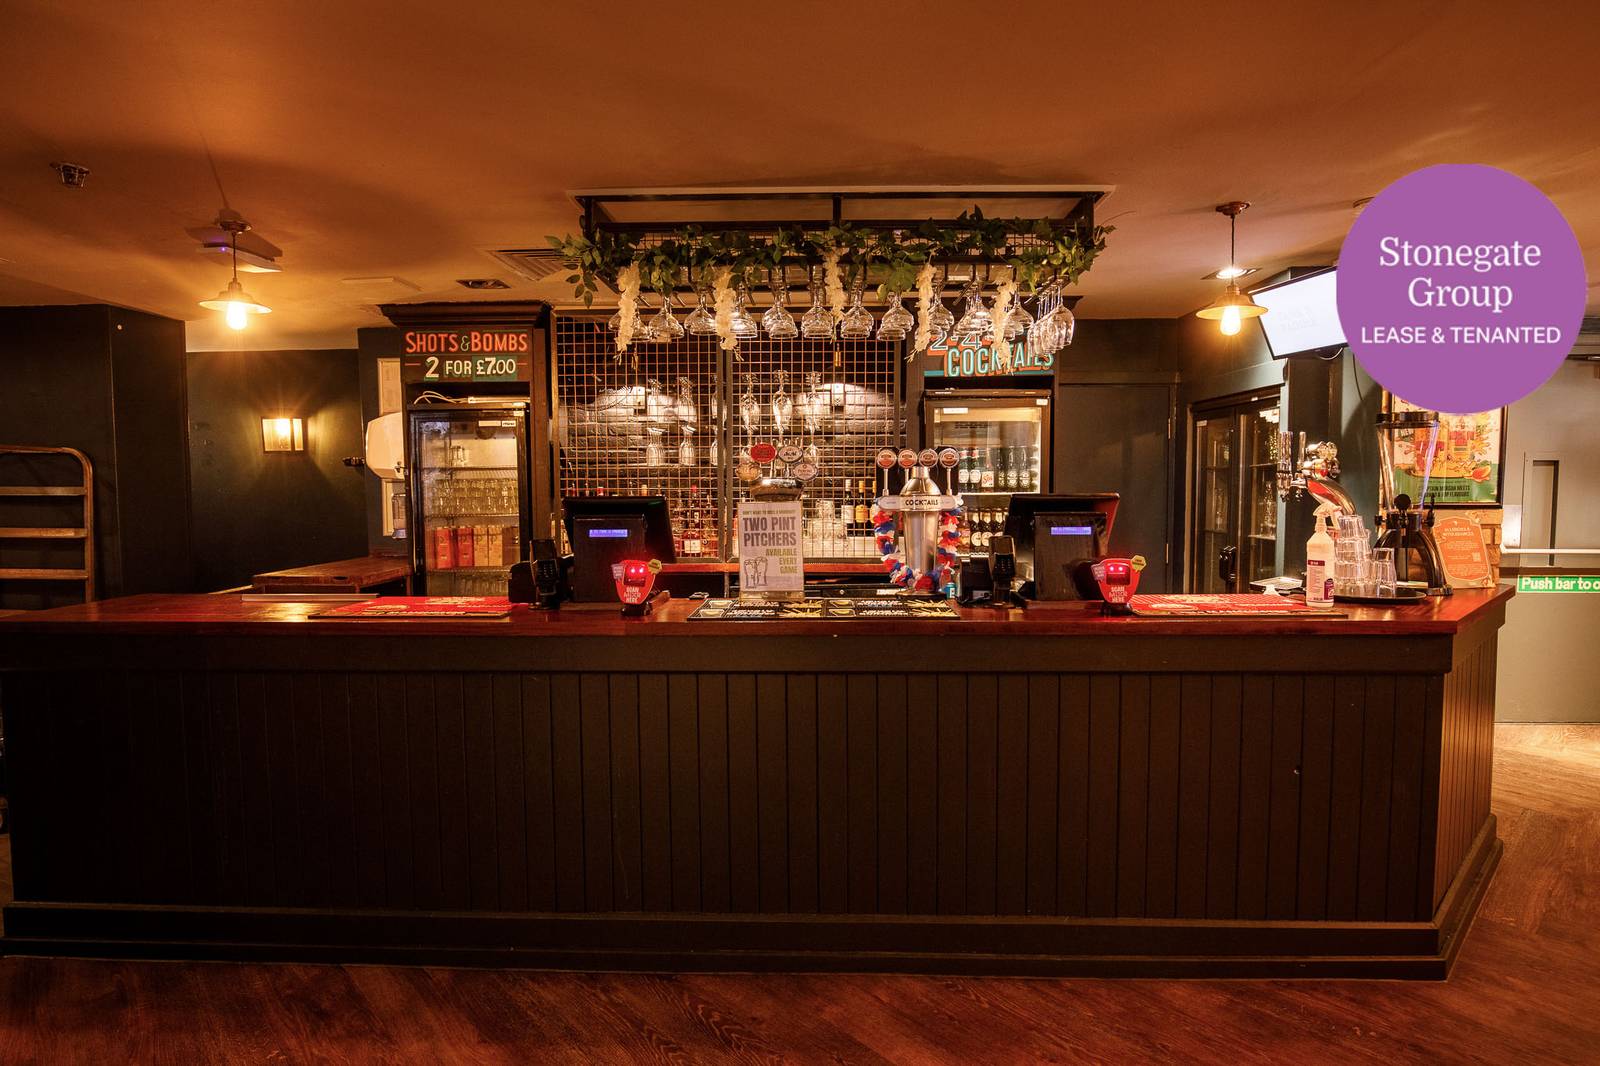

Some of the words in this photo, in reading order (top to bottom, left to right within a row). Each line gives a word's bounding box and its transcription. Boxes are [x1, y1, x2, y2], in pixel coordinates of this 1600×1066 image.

[405, 331, 459, 353] SHOTS
[460, 335, 470, 352] &
[471, 331, 528, 352] BOMBS
[425, 356, 440, 378] 2
[445, 360, 472, 375] FOR
[476, 356, 516, 375] £7.00
[743, 517, 768, 531] TWO
[772, 516, 796, 530] PINT
[744, 532, 796, 546] PITCHERS
[1522, 576, 1553, 590] Push
[1555, 577, 1576, 590] bar
[1577, 577, 1592, 590] to
